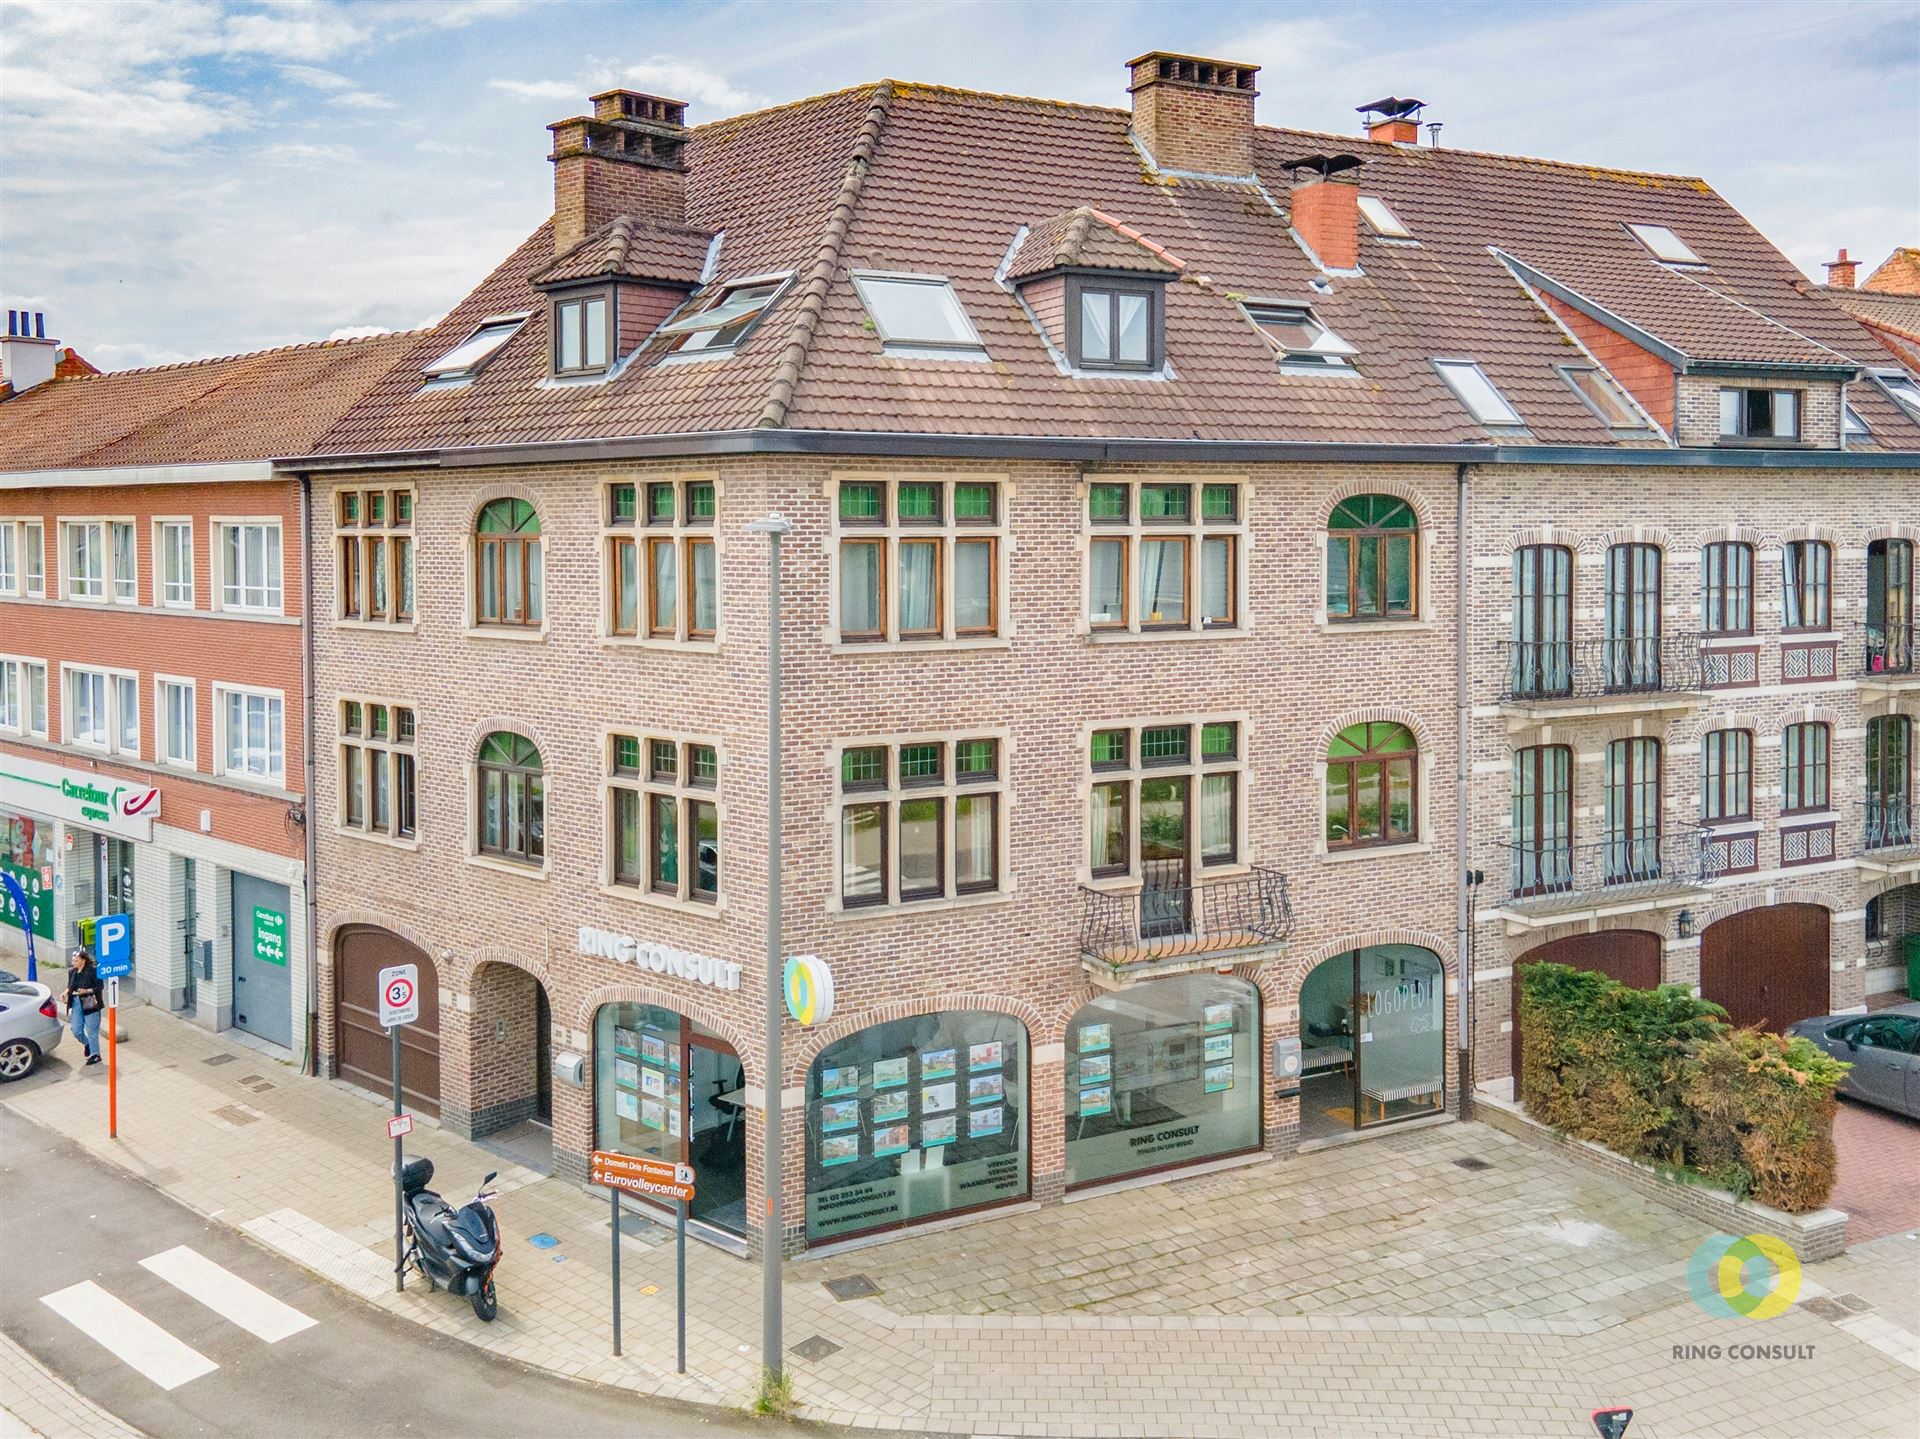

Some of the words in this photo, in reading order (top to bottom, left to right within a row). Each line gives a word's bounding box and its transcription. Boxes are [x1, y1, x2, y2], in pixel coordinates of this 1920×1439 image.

[62, 778, 109, 805] Carrefour
[101, 922, 125, 956] P
[258, 927, 281, 947] Ingang
[100, 966, 112, 975] 30
[113, 964, 128, 973] min
[578, 926, 637, 963] RING
[636, 941, 743, 991] CONSULT
[1130, 1134, 1155, 1147] RING
[1157, 1125, 1200, 1141] CONSULT
[604, 1158, 628, 1169] Domein
[629, 1162, 642, 1172] Drie
[604, 1172, 688, 1197] Eurovolleycenter
